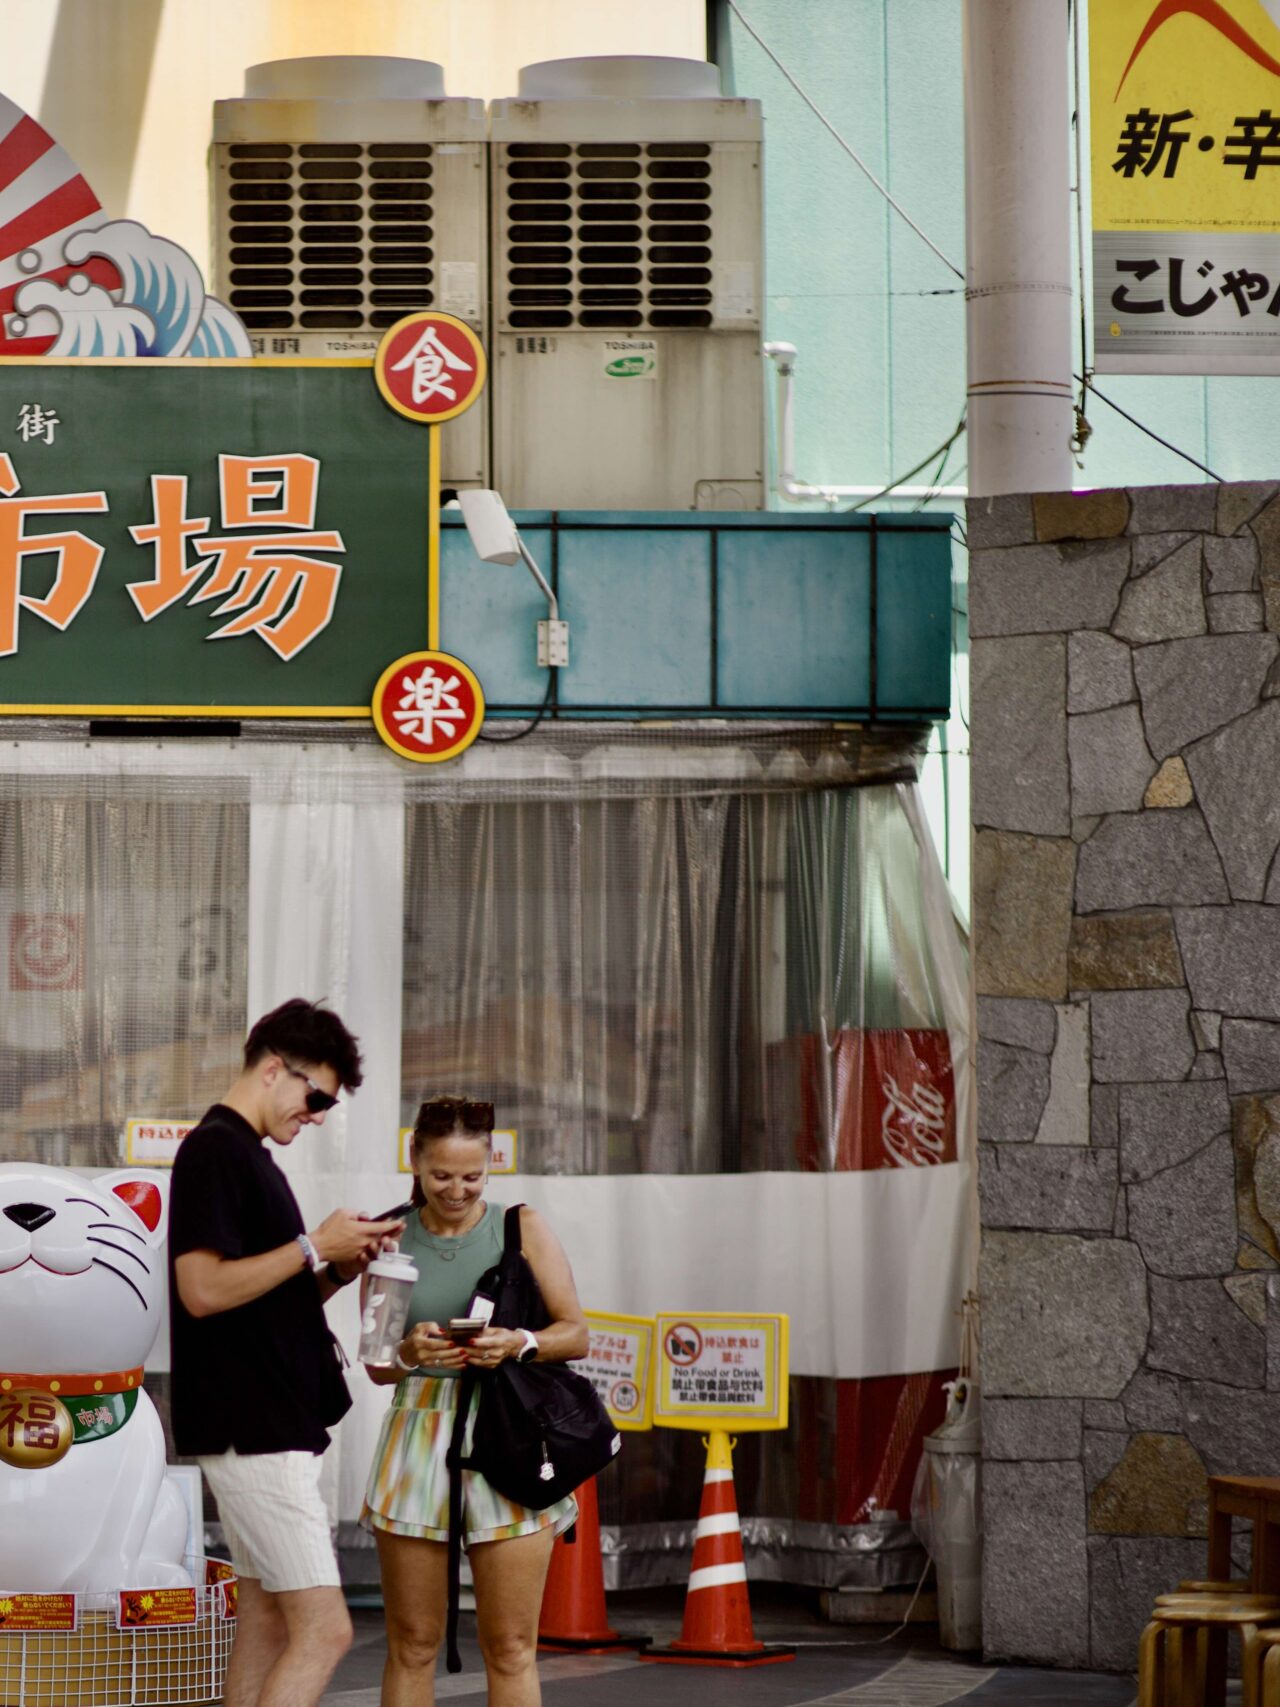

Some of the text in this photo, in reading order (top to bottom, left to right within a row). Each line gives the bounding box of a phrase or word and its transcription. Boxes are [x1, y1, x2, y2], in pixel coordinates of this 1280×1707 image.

[1111, 107, 1280, 181] 新・辛
[1111, 257, 1280, 318] こじゃ
[326, 341, 377, 351] TOSHIBA
[391, 326, 474, 404] 食
[604, 341, 656, 351] TOSHIBA
[392, 666, 467, 746] 楽
[675, 1367, 689, 1376] No
[691, 1367, 717, 1377] Food
[732, 1368, 760, 1378] Drink
[76, 1407, 114, 1427] 市場
